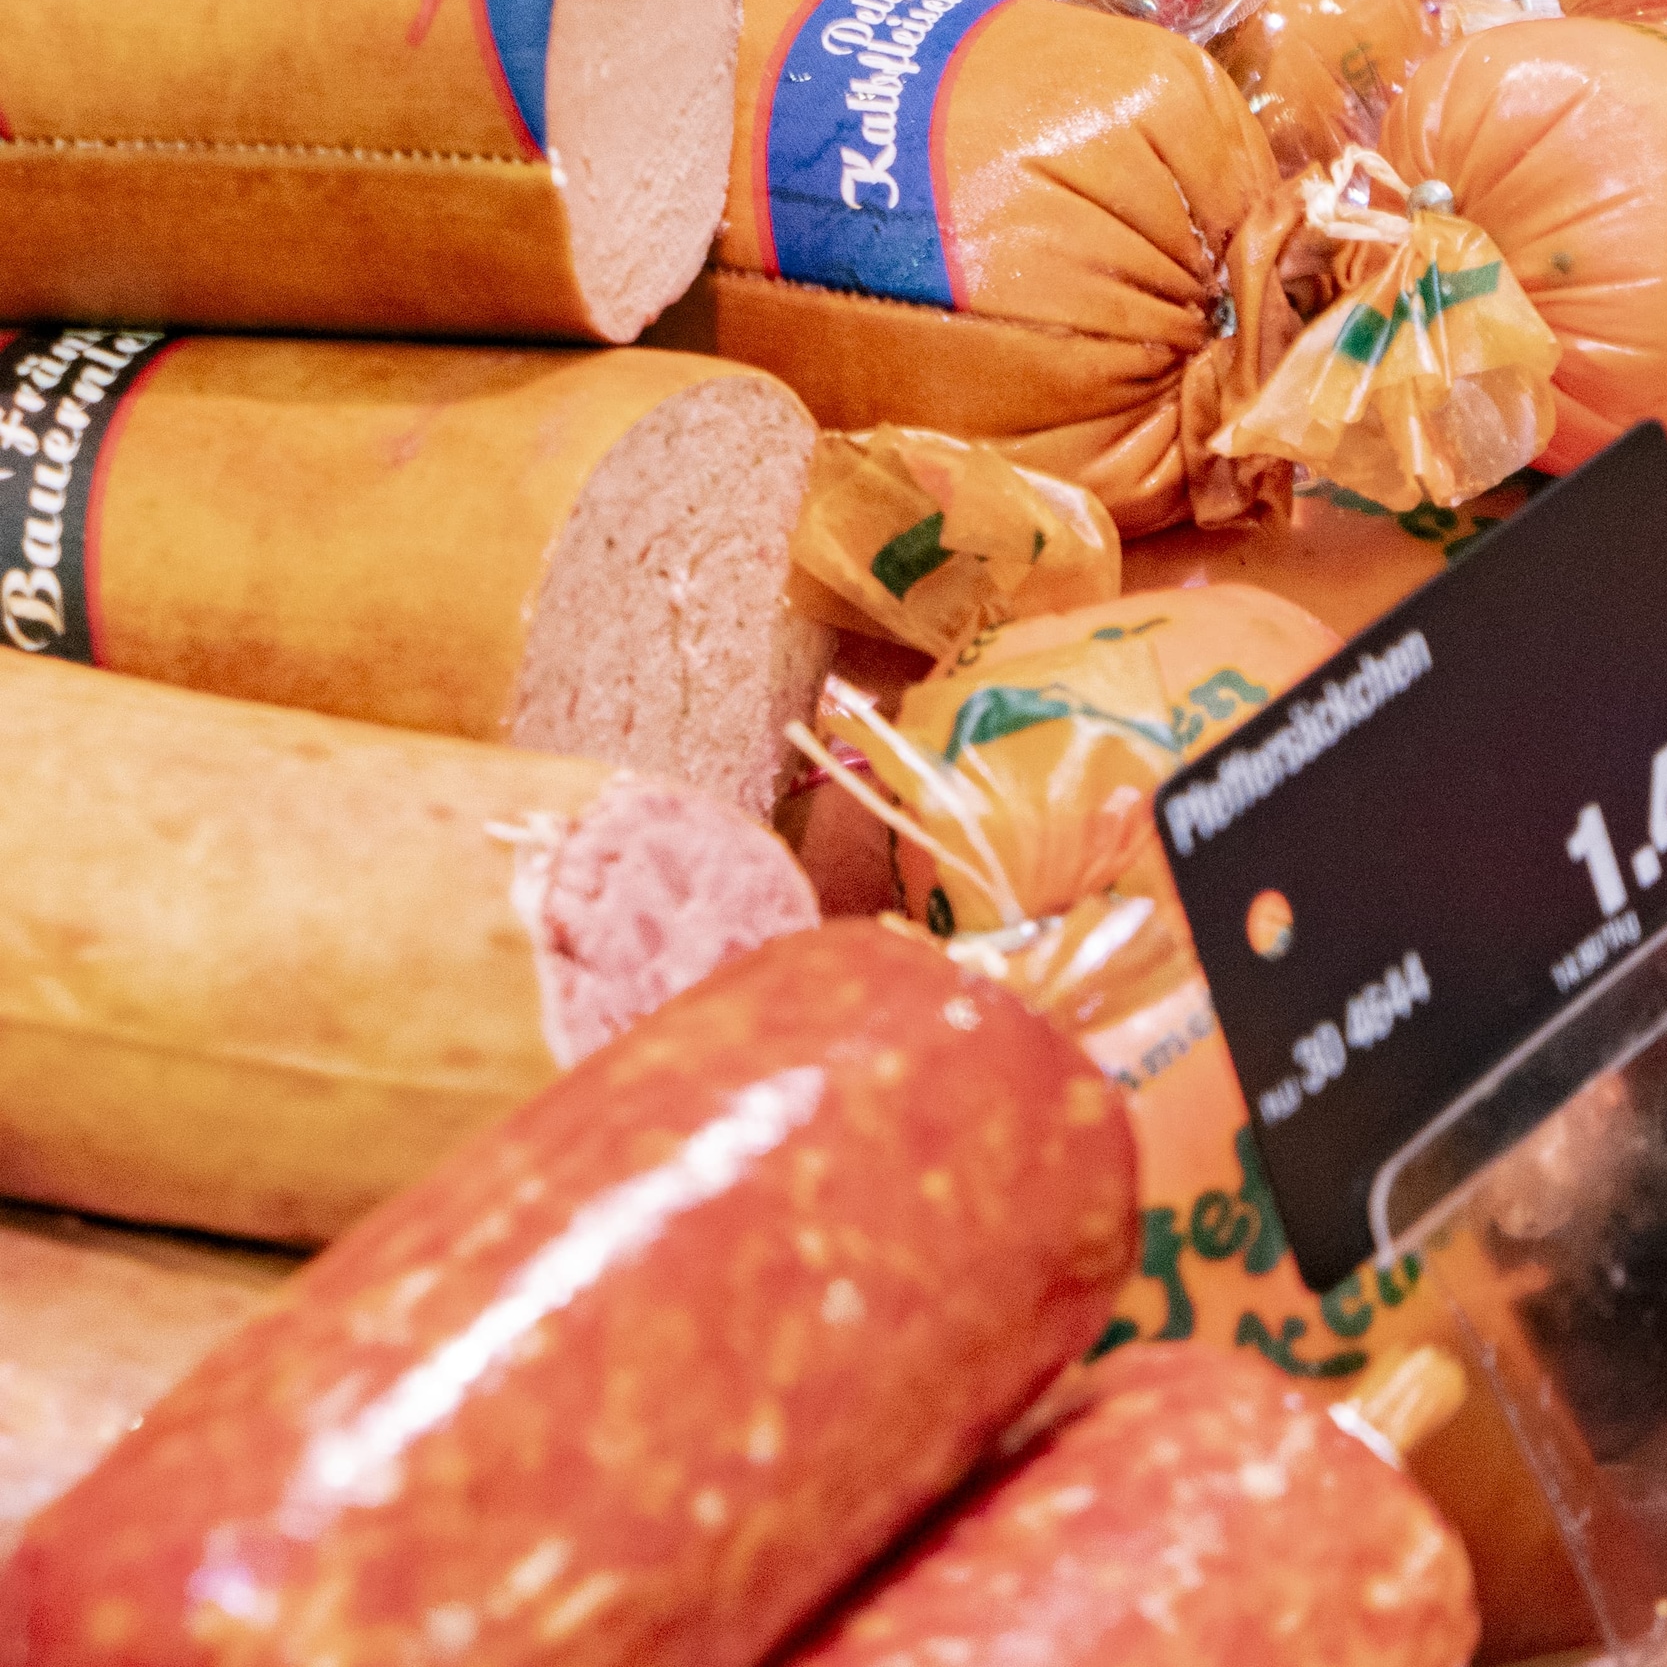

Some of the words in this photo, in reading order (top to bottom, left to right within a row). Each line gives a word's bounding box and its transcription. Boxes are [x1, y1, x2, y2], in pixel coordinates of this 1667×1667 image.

[1165, 631, 1432, 856] Pfeffersäckchen
[1293, 1020, 1347, 1095] 30
[1345, 949, 1431, 1049] 4644
